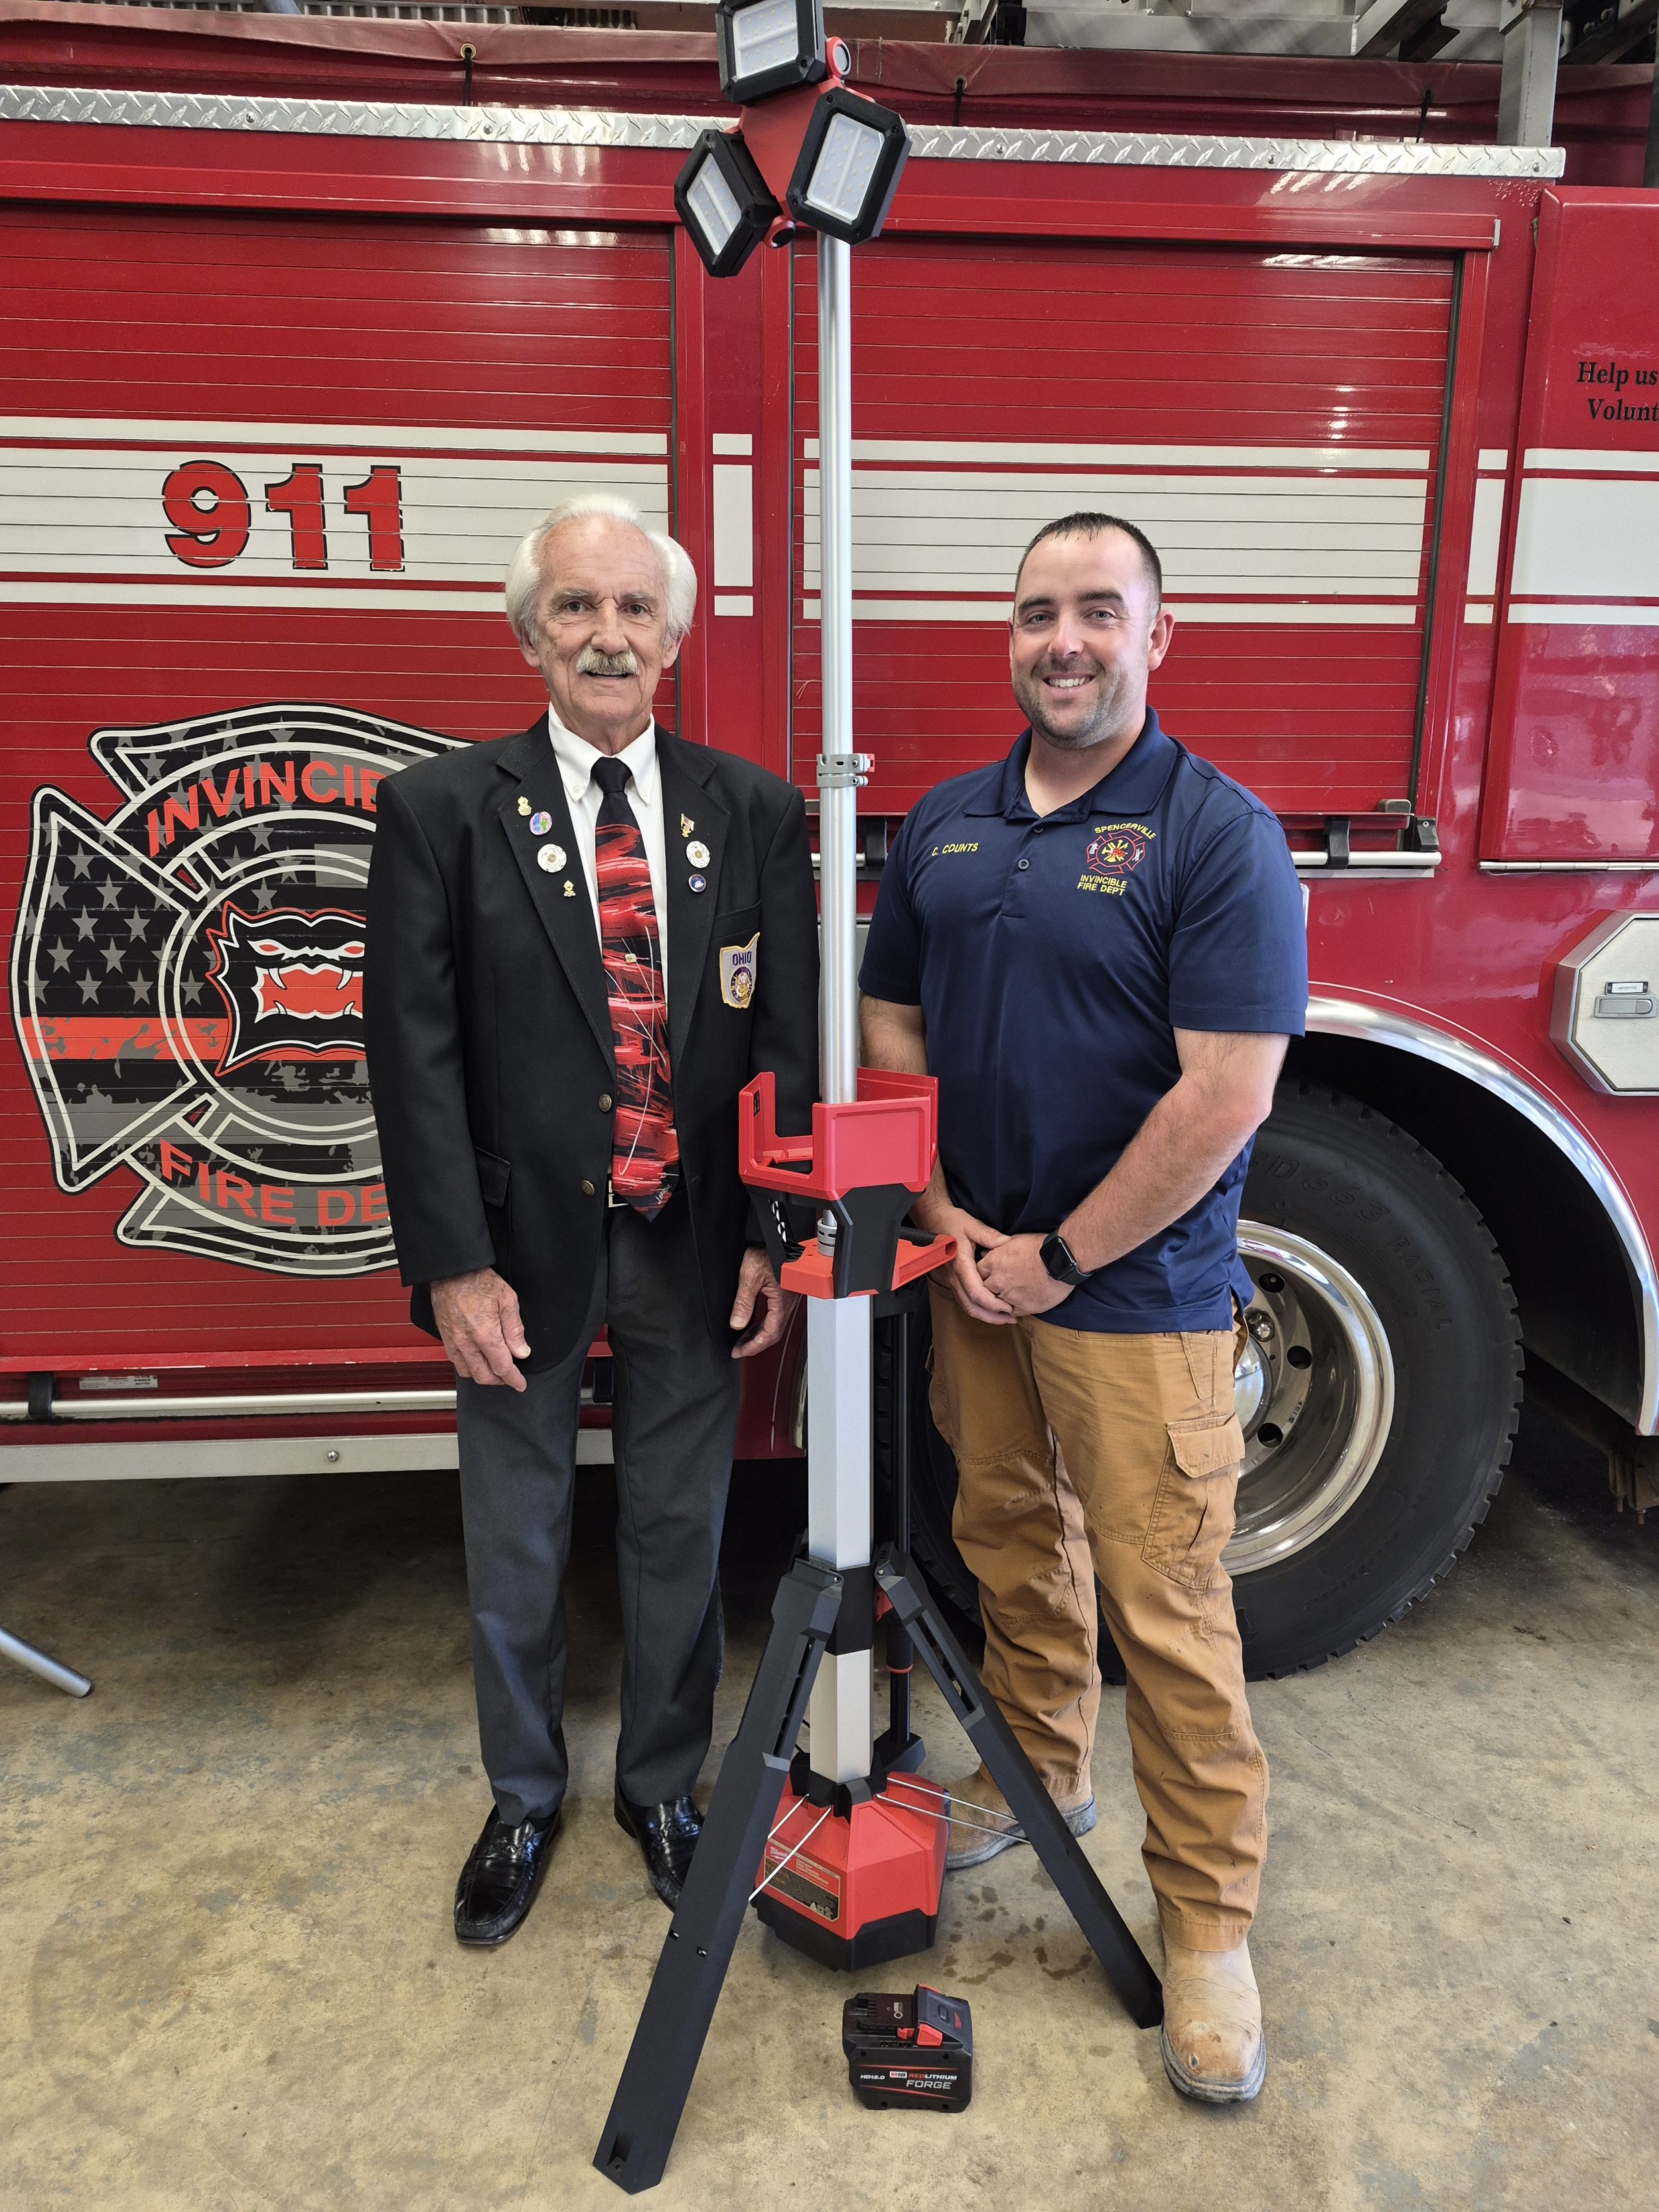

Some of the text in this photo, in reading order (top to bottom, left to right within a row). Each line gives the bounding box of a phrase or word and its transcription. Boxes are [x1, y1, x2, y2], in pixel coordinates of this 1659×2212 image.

[1577, 361, 1659, 392] Help us
[161, 459, 405, 572] 911
[1094, 823, 1157, 840] SPENCERVILLE
[931, 842, 979, 857] C. COUNTS
[1077, 882, 1125, 896] FIRE DEPT
[1080, 874, 1128, 889] INVINCIBLE
[732, 951, 752, 966] OHIO
[159, 1138, 296, 1225] FIRE
[906, 2080, 952, 2089] FORGE
